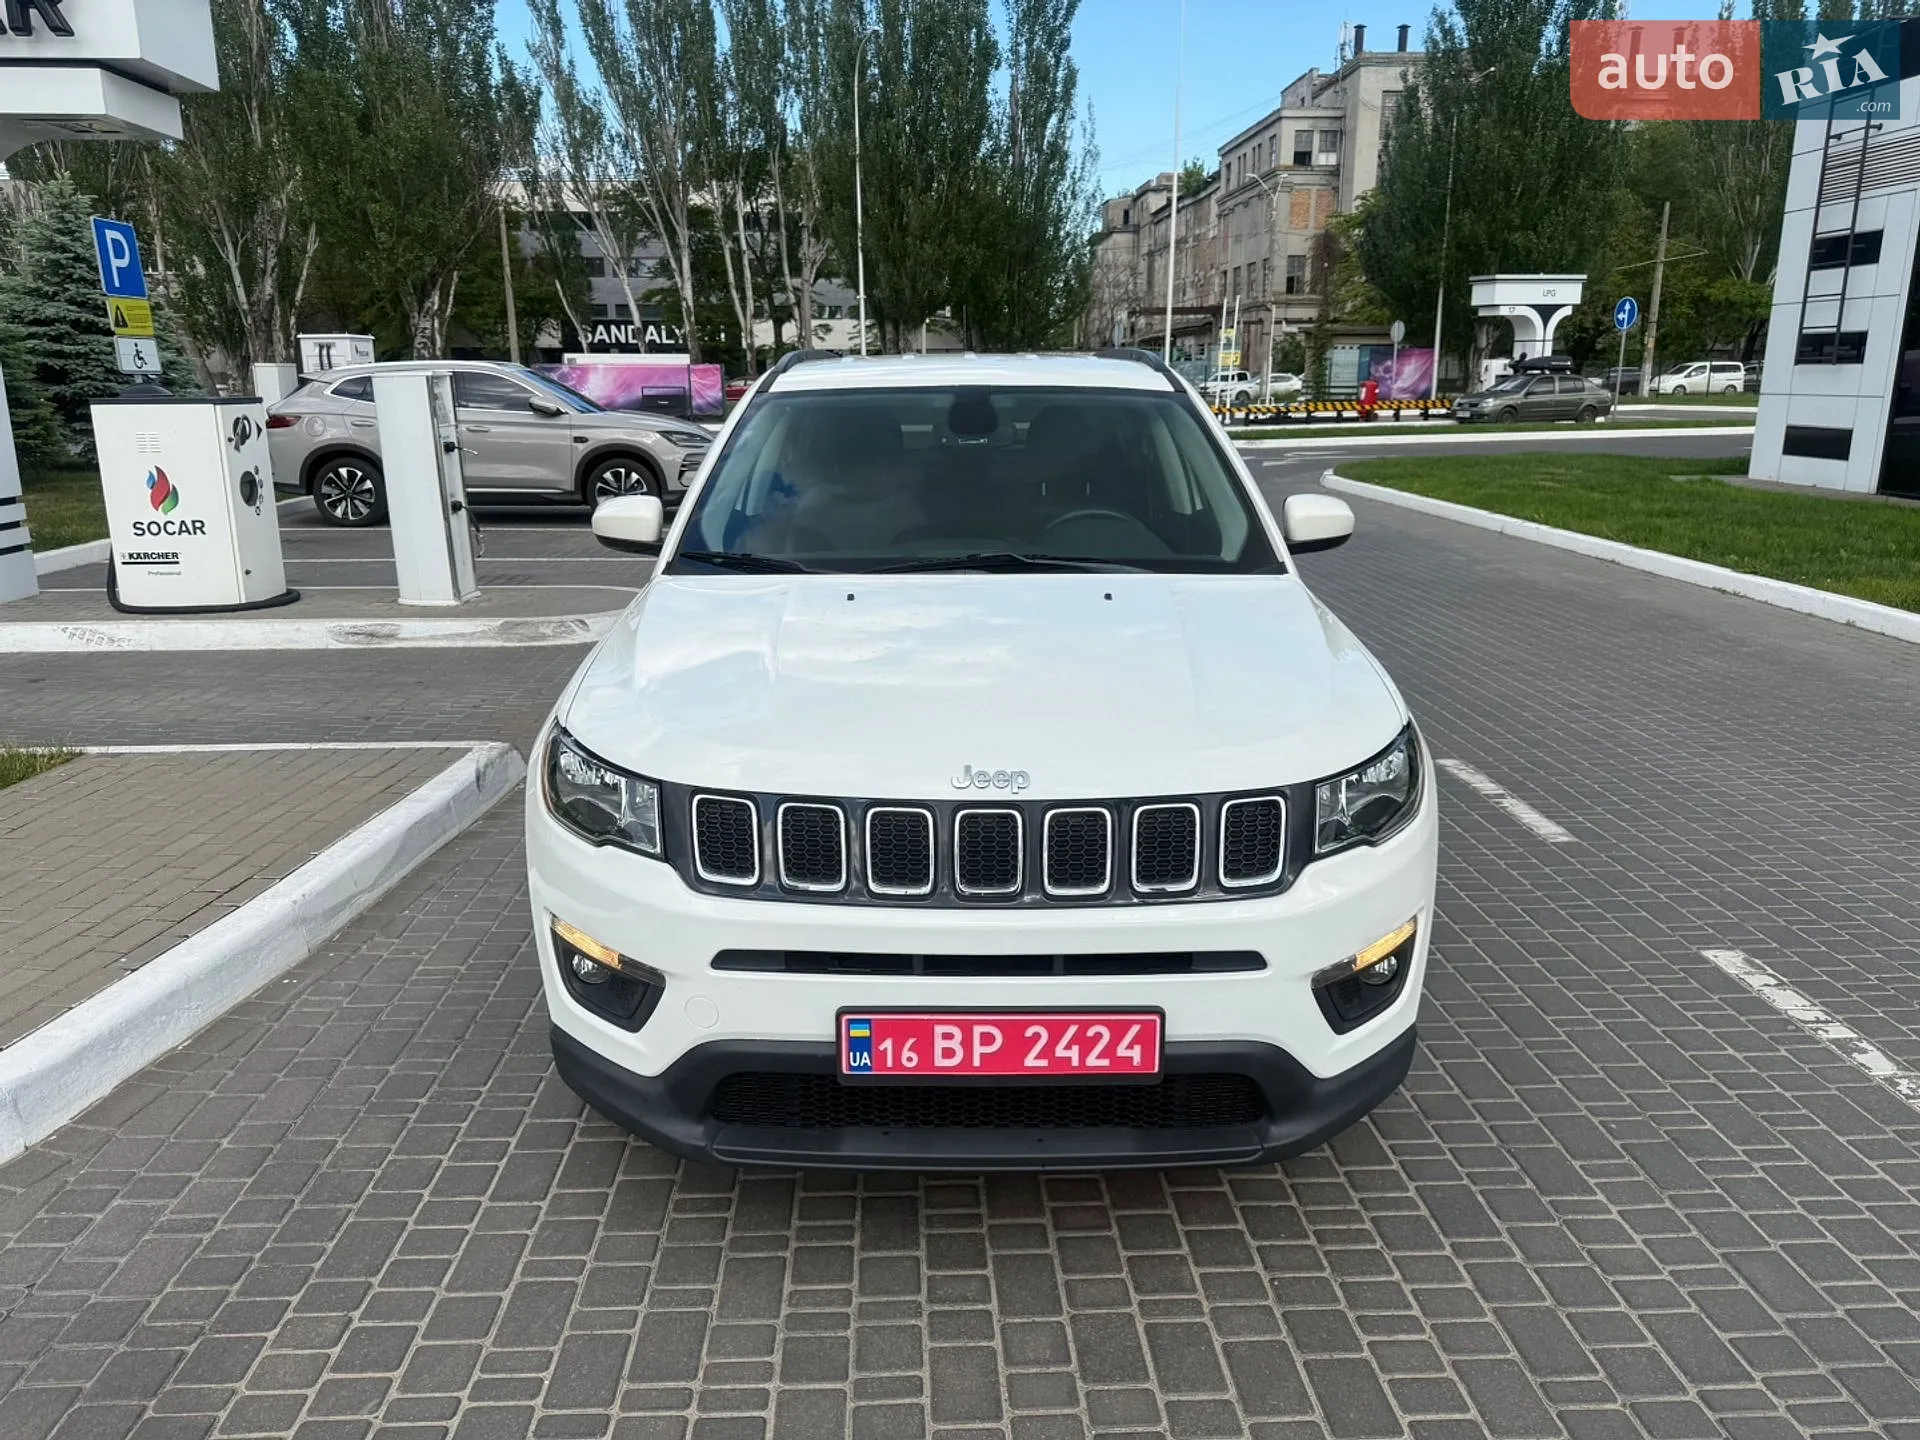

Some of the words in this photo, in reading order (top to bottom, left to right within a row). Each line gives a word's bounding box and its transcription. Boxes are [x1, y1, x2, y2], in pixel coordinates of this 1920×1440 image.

[104, 229, 131, 288] P
[1542, 289, 1556, 298] LPG
[132, 519, 207, 537] SOCAR
[951, 764, 1031, 795] Jeep
[878, 1037, 919, 1068] 16
[933, 1024, 1004, 1068] BP
[1023, 1024, 1143, 1068] 2424
[849, 1051, 872, 1067] UA
